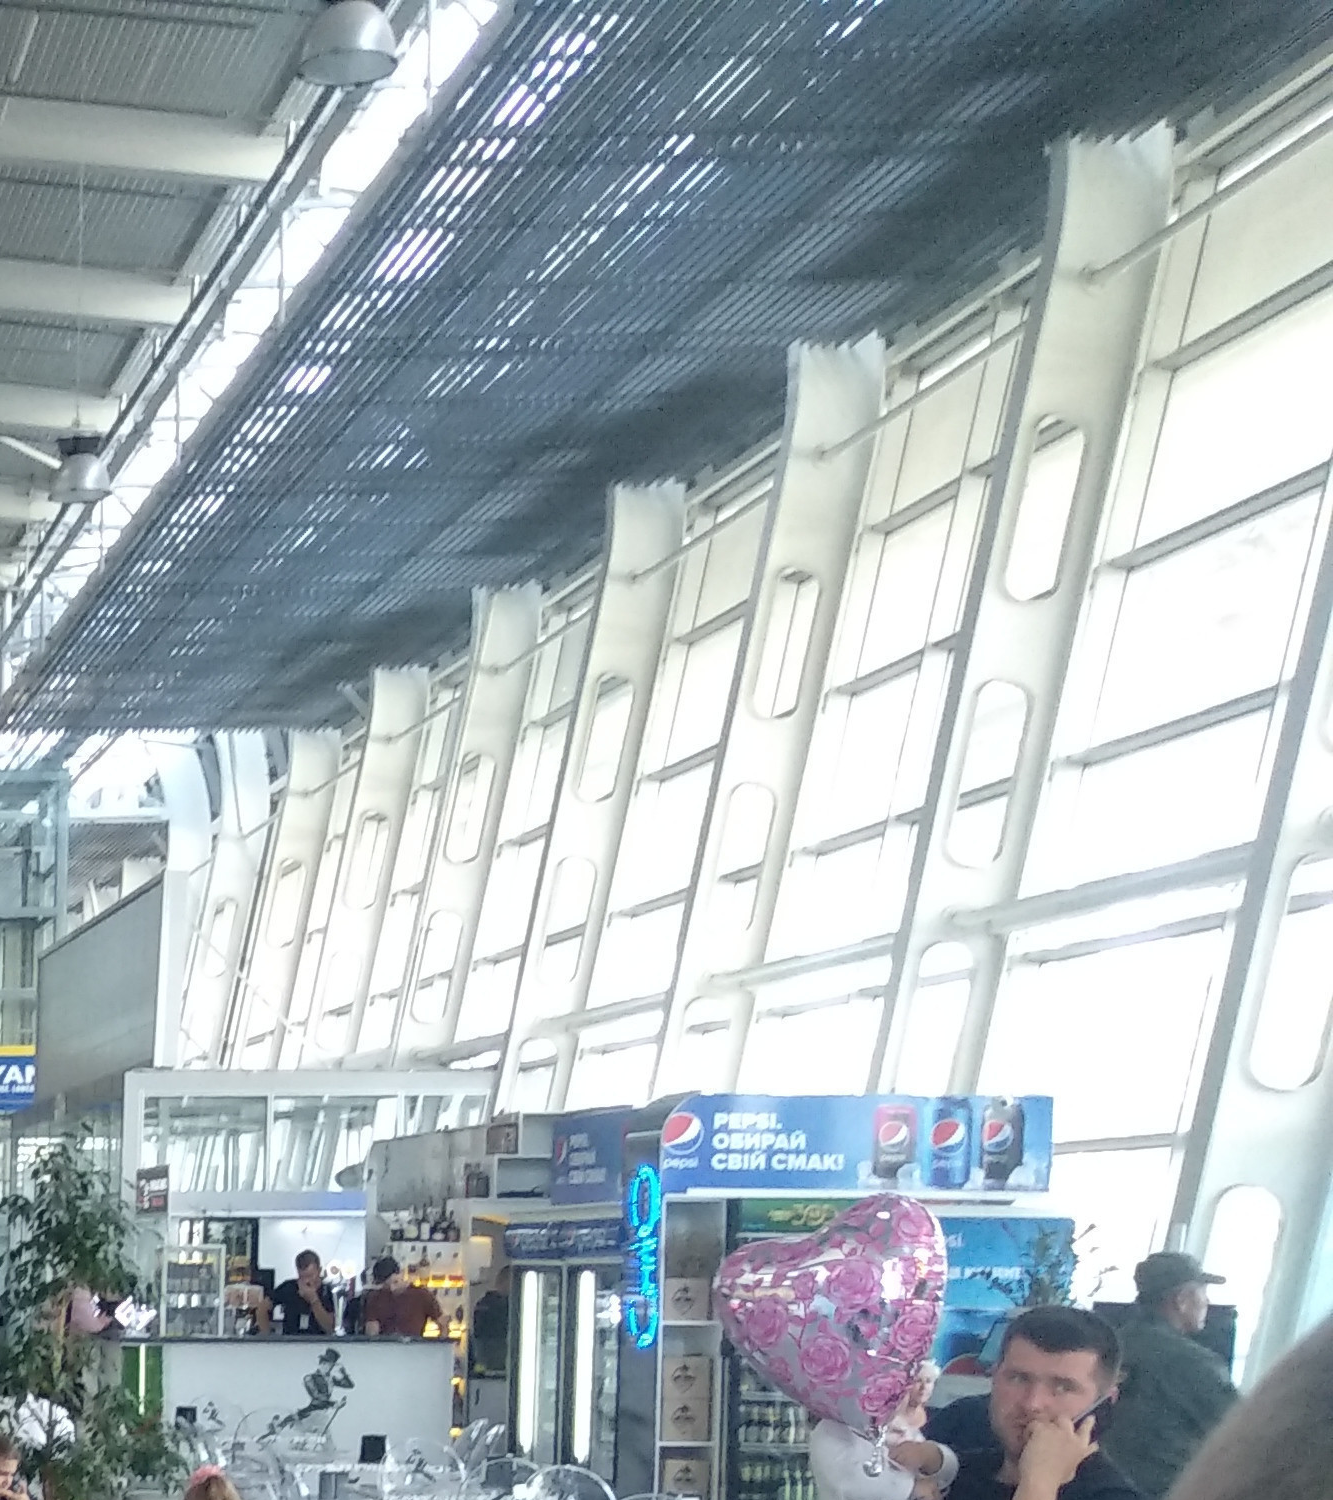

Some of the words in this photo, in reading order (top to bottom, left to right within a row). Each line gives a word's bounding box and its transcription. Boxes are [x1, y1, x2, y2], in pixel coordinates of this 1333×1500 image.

[713, 1112, 782, 1129] PEPSI.
[712, 1131, 807, 1151] ОБИРАЙ
[711, 1152, 767, 1172] СВІЙ
[771, 1153, 845, 1172] СМАК!
